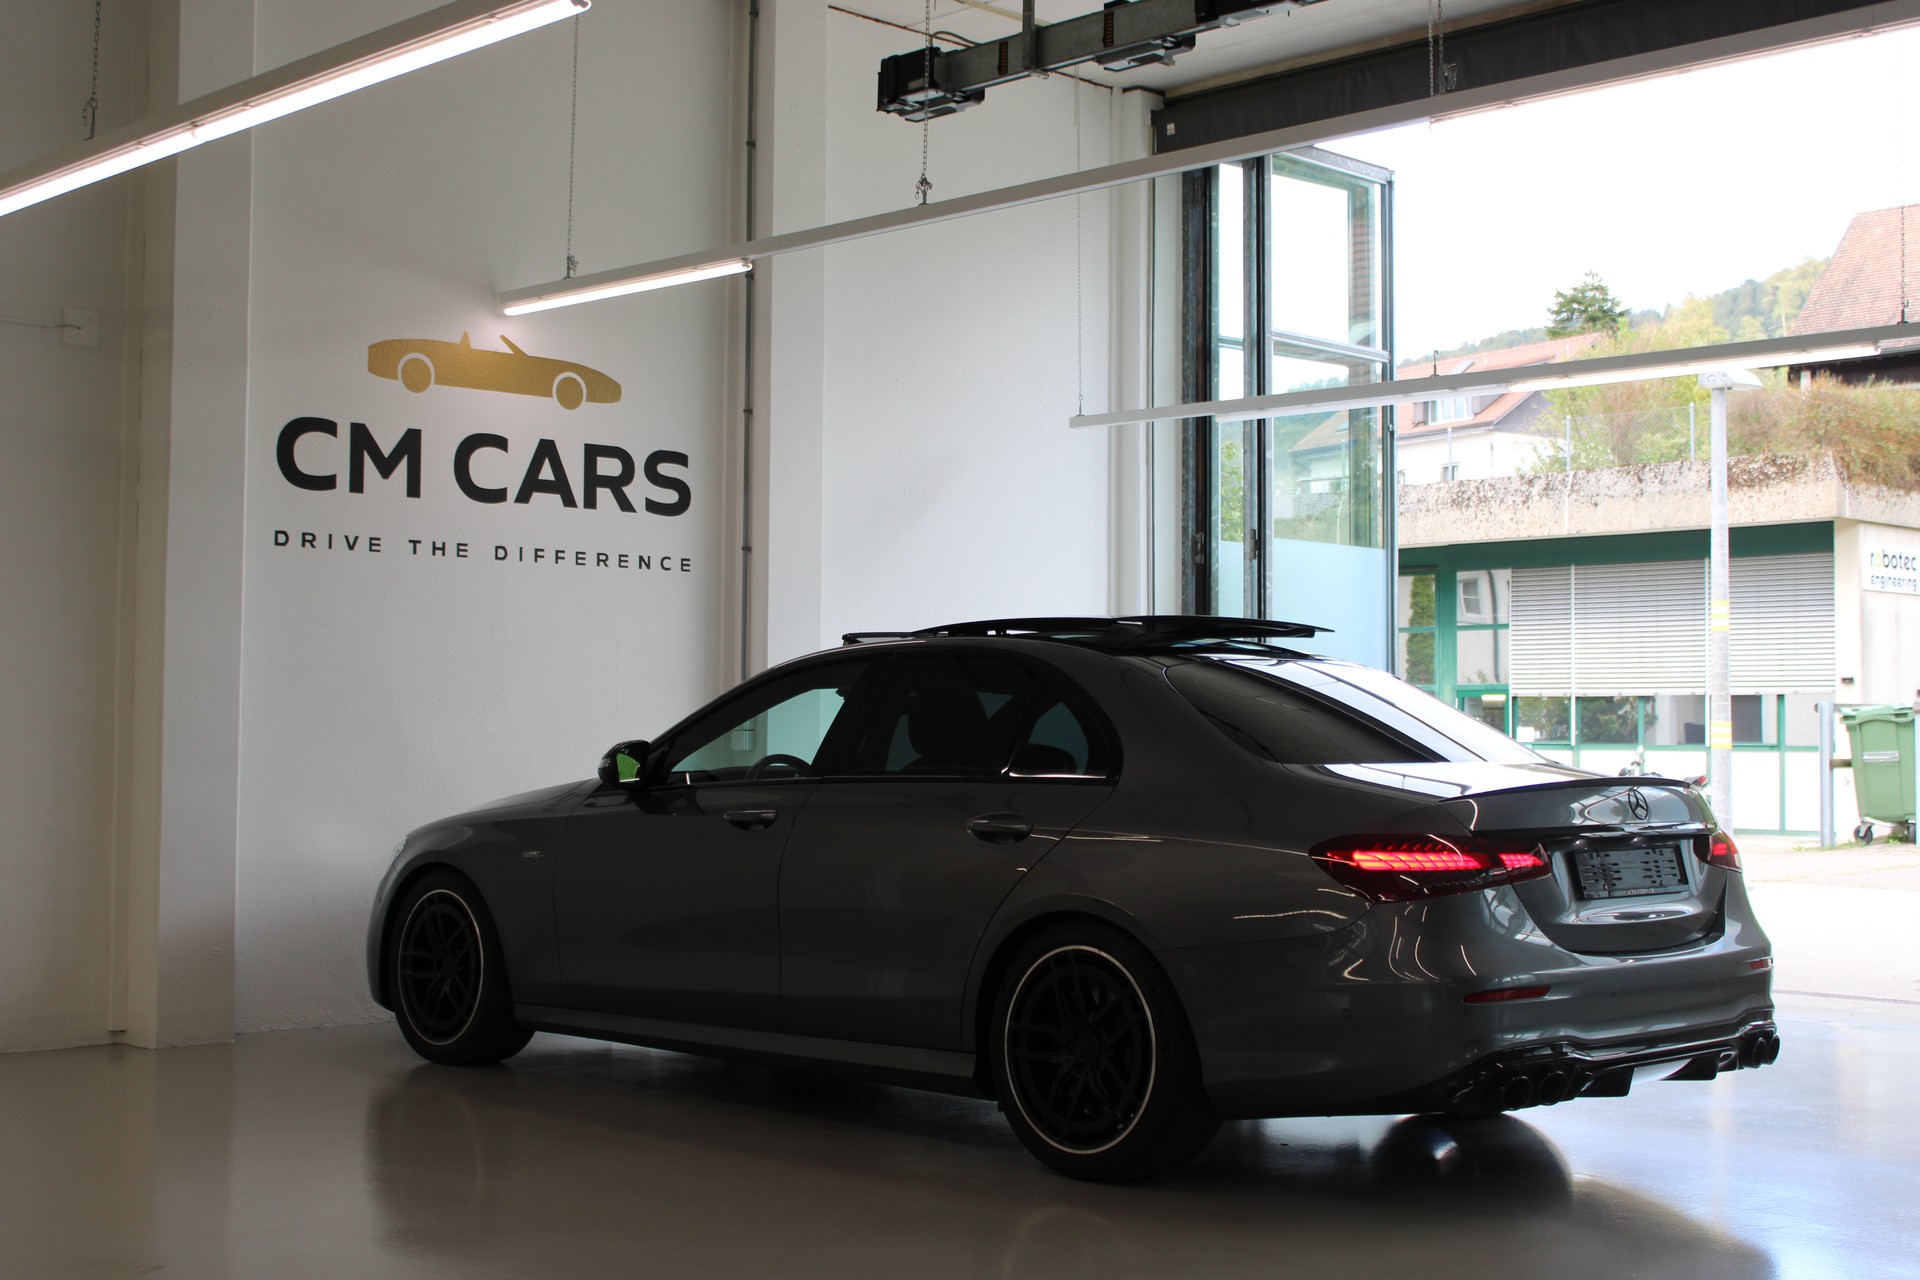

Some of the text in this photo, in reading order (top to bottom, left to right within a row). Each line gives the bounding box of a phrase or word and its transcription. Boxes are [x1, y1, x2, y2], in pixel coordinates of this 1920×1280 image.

[275, 416, 692, 517] CM CARS
[274, 529, 691, 573] DRIVE THE DIFFERENCE
[1870, 549, 1917, 571] robotec
[1870, 574, 1918, 592] engineering
